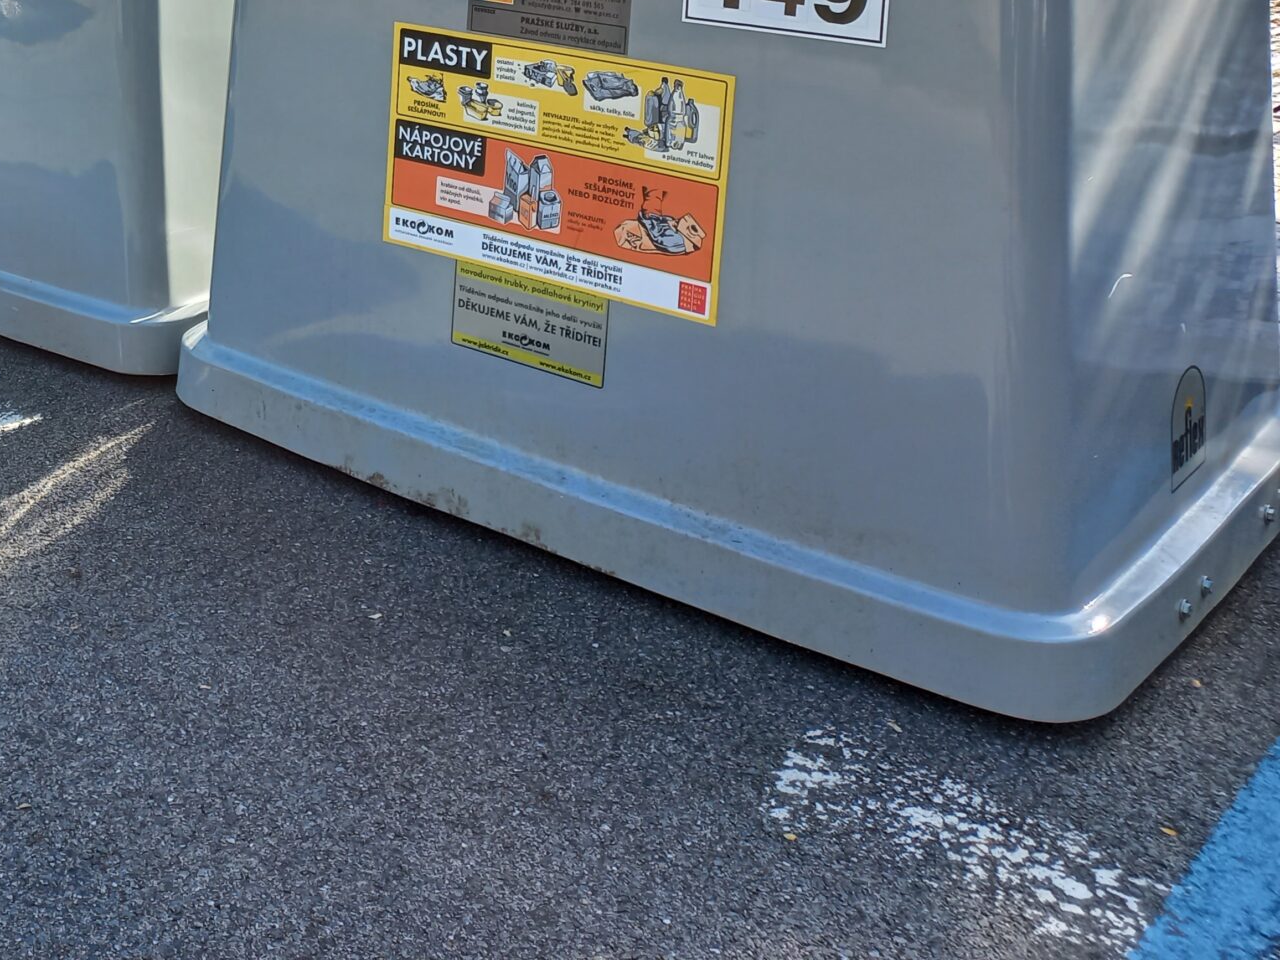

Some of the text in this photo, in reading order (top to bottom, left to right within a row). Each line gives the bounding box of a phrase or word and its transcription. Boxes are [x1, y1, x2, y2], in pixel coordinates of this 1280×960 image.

[521, 16, 554, 29] PRAŽSKÉ
[556, 20, 586, 34] SLUŽBY,
[403, 36, 488, 71] PLASTY
[408, 105, 446, 118] SEŠLÁPNOUT!
[414, 99, 440, 111] PROSÍME,
[399, 126, 482, 156] NÁPOJOVÉ
[402, 142, 477, 170] KARTONY
[698, 152, 714, 161] lahve
[584, 182, 635, 199] SEŠLÁPNOUT
[597, 175, 635, 191] PROSÍME,
[568, 189, 634, 209] NEBO ROZLOŽIT!
[482, 233, 509, 245] Tříděním
[510, 239, 535, 252] odpadu
[481, 241, 623, 285] DĚKUJEME VÁM, ŽE TŘÍDÍTE!
[460, 268, 503, 284] novodurové
[504, 278, 530, 293] trubky,
[531, 284, 571, 303] podlahové
[573, 294, 603, 312] krytiny!
[458, 284, 486, 297] Tříděním
[487, 291, 512, 305] odpadu
[545, 306, 560, 320] jeho
[458, 296, 602, 348] DĚKUJEME VÁM, ŽE TŘÍDÍTE!
